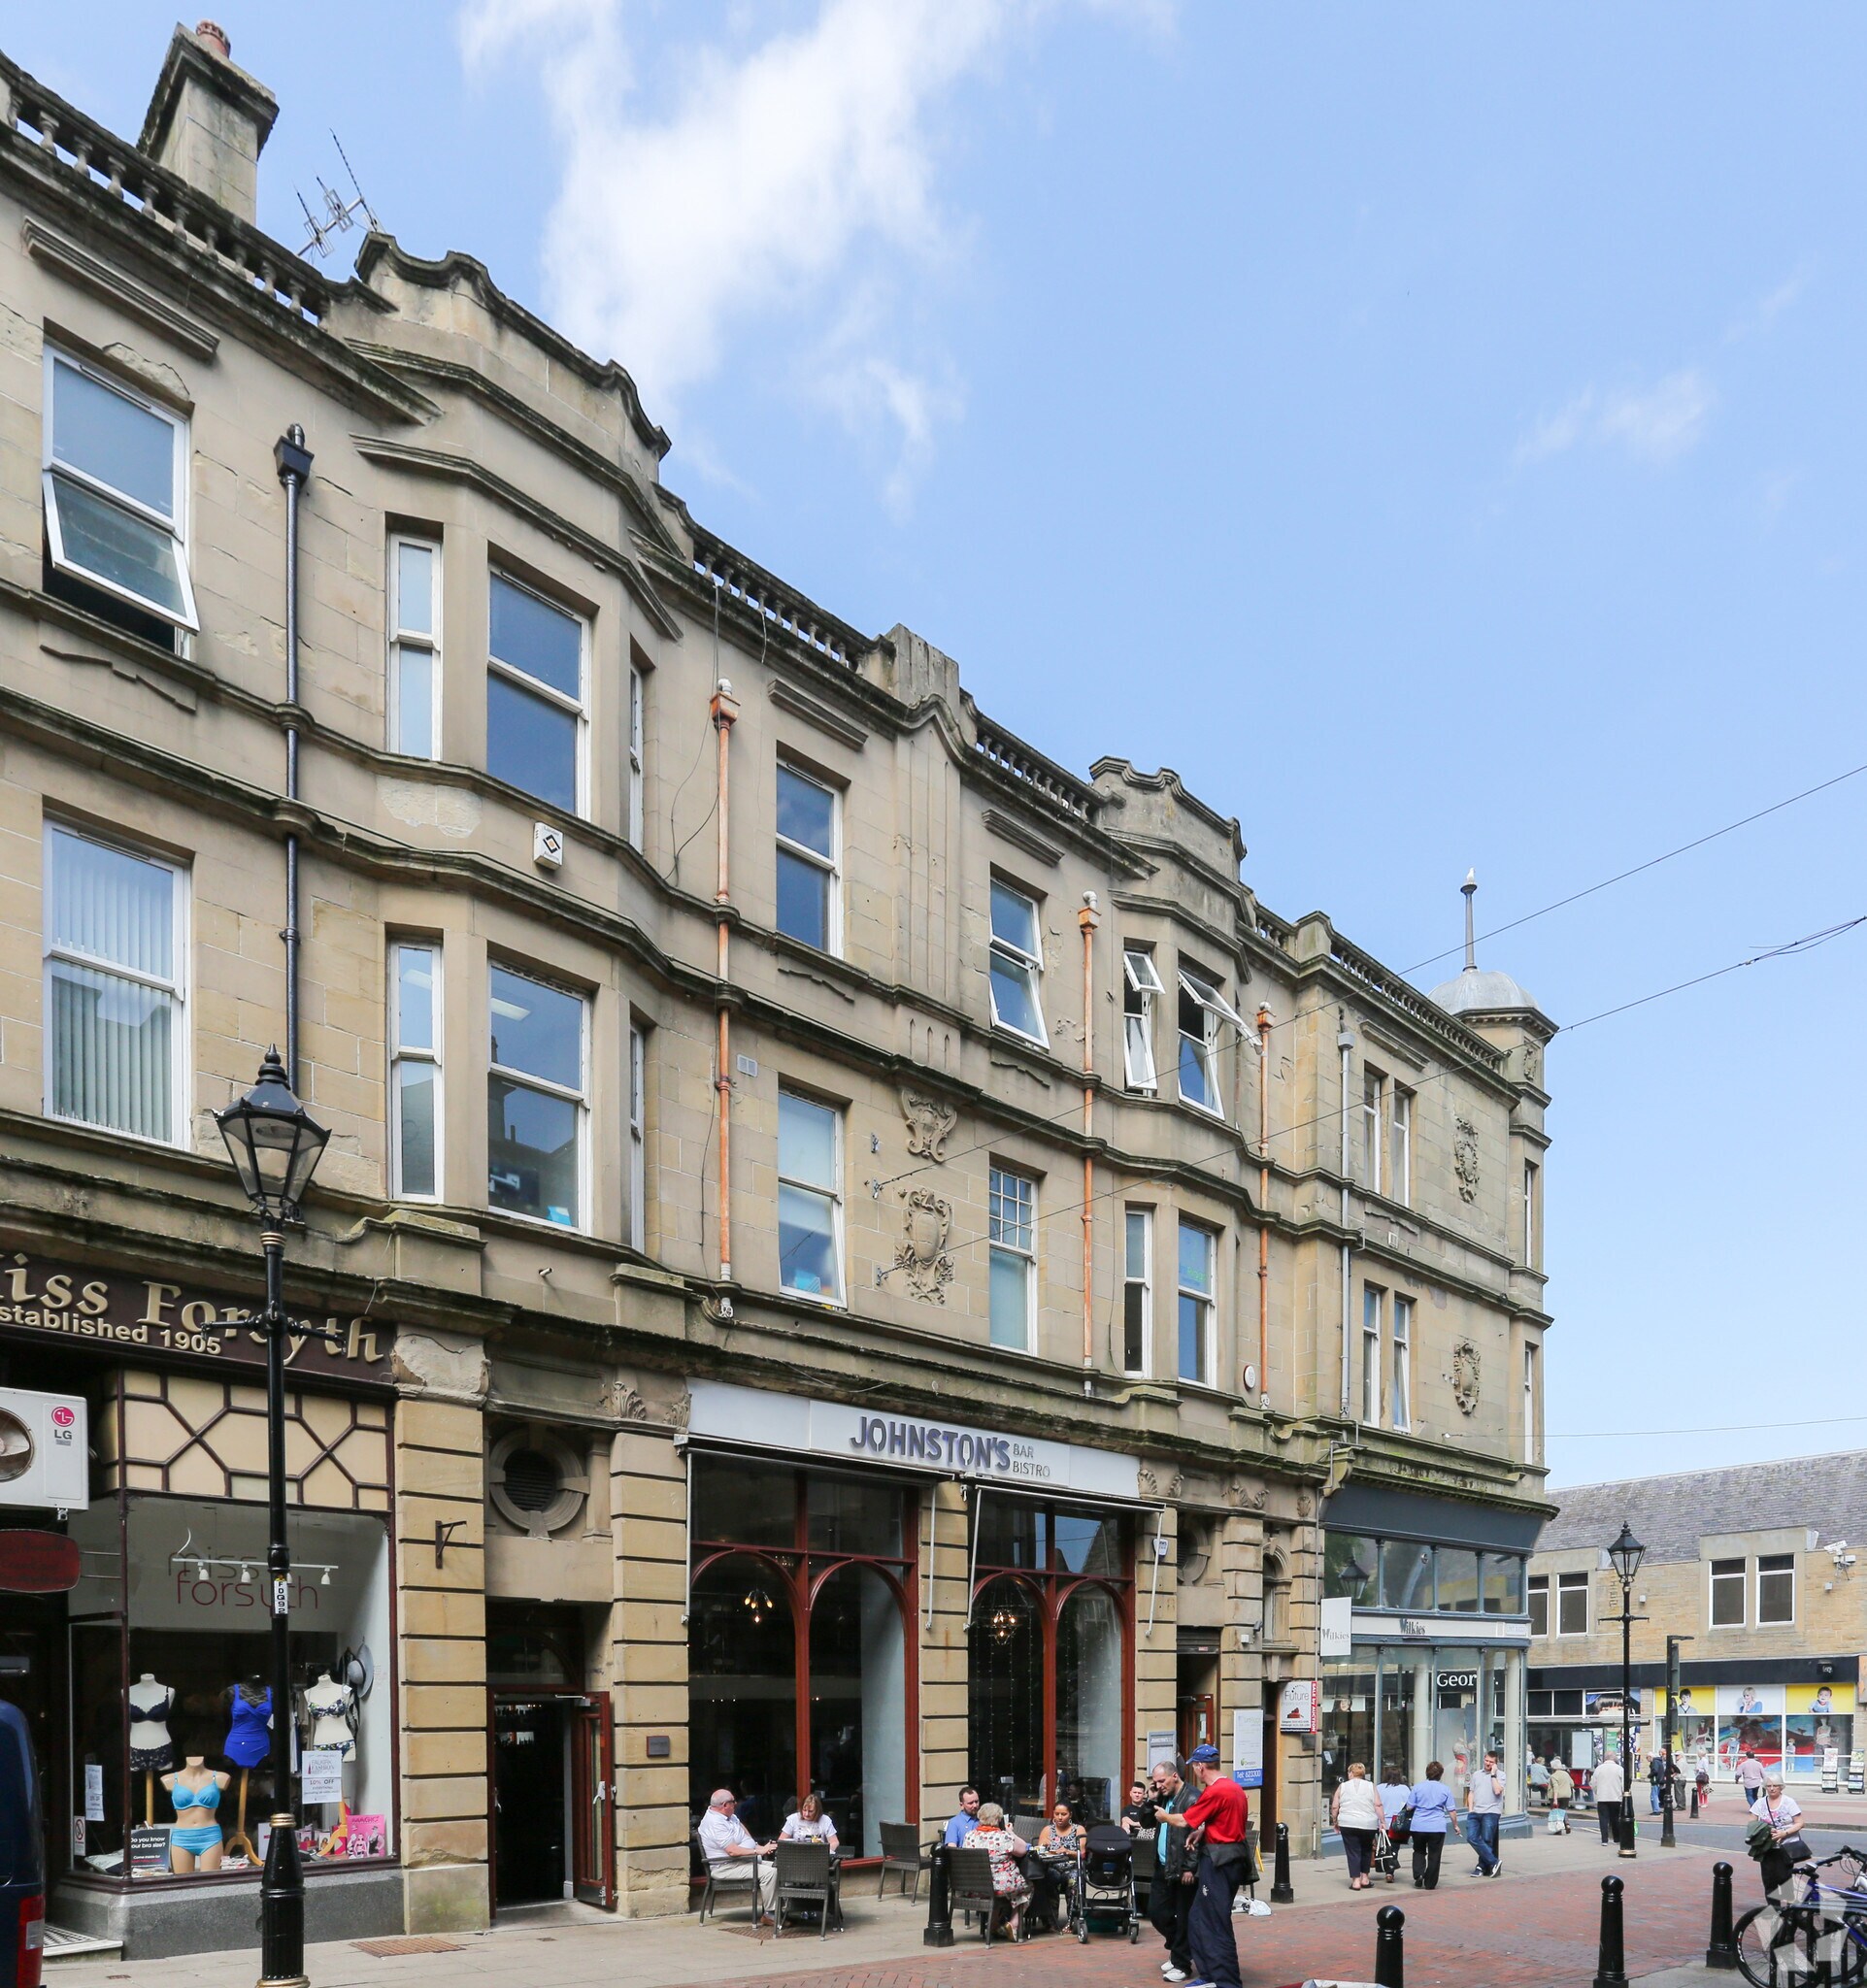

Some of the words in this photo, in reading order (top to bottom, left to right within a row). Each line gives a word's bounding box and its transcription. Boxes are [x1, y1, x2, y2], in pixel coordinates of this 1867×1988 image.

[0, 1252, 109, 1315] iss
[0, 1305, 148, 1344] stablished
[159, 1329, 221, 1355] 1905
[54, 1429, 73, 1440] LG
[850, 1415, 1011, 1472] JOHNSTON'S
[1013, 1442, 1034, 1459] BAR
[1012, 1460, 1051, 1477] BISTRO
[168, 1546, 260, 1580] miss
[1321, 1628, 1350, 1640] Wilkies
[1399, 1618, 1426, 1635] Wilkies
[1284, 1690, 1310, 1701] Future
